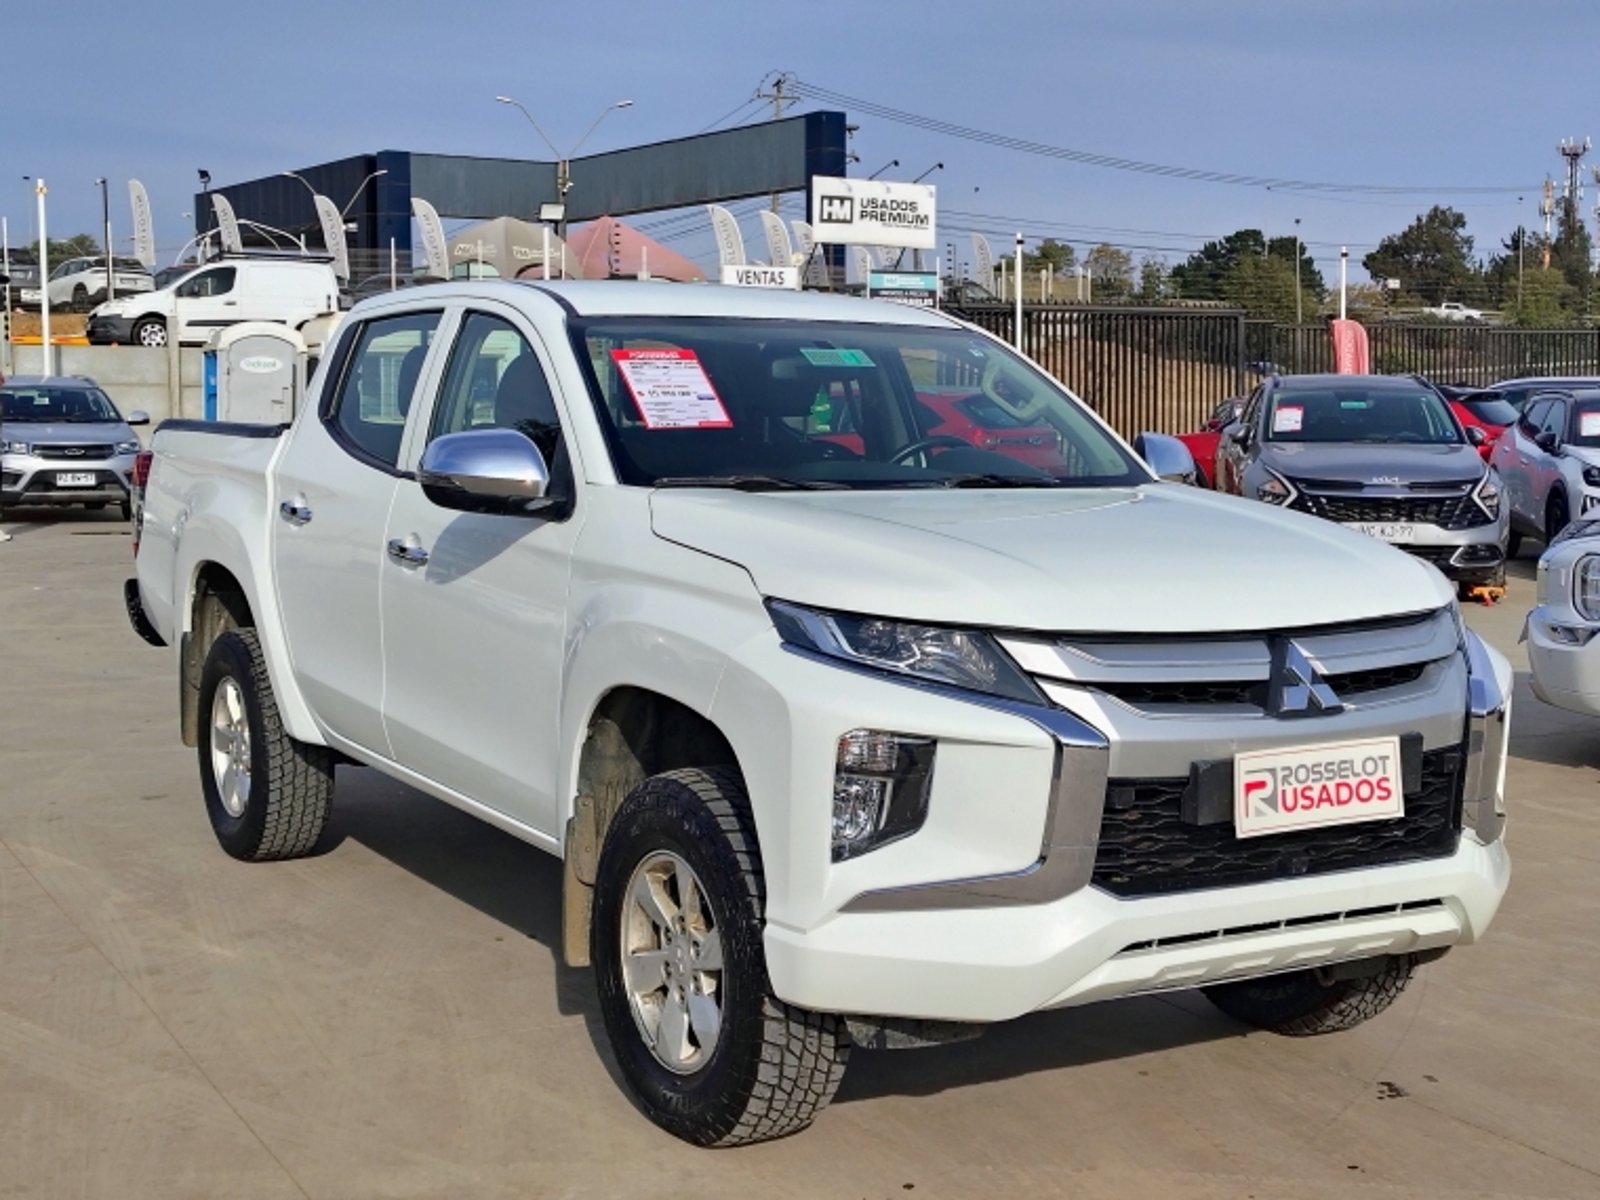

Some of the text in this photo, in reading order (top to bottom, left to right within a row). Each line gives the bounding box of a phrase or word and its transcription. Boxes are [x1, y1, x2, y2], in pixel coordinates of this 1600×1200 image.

[859, 198, 919, 213] USADOS
[859, 210, 930, 226] PREMIUM
[736, 270, 785, 285] VENTAS
[1280, 756, 1391, 787] ROSSELOT
[1281, 777, 1393, 813] USADOS
